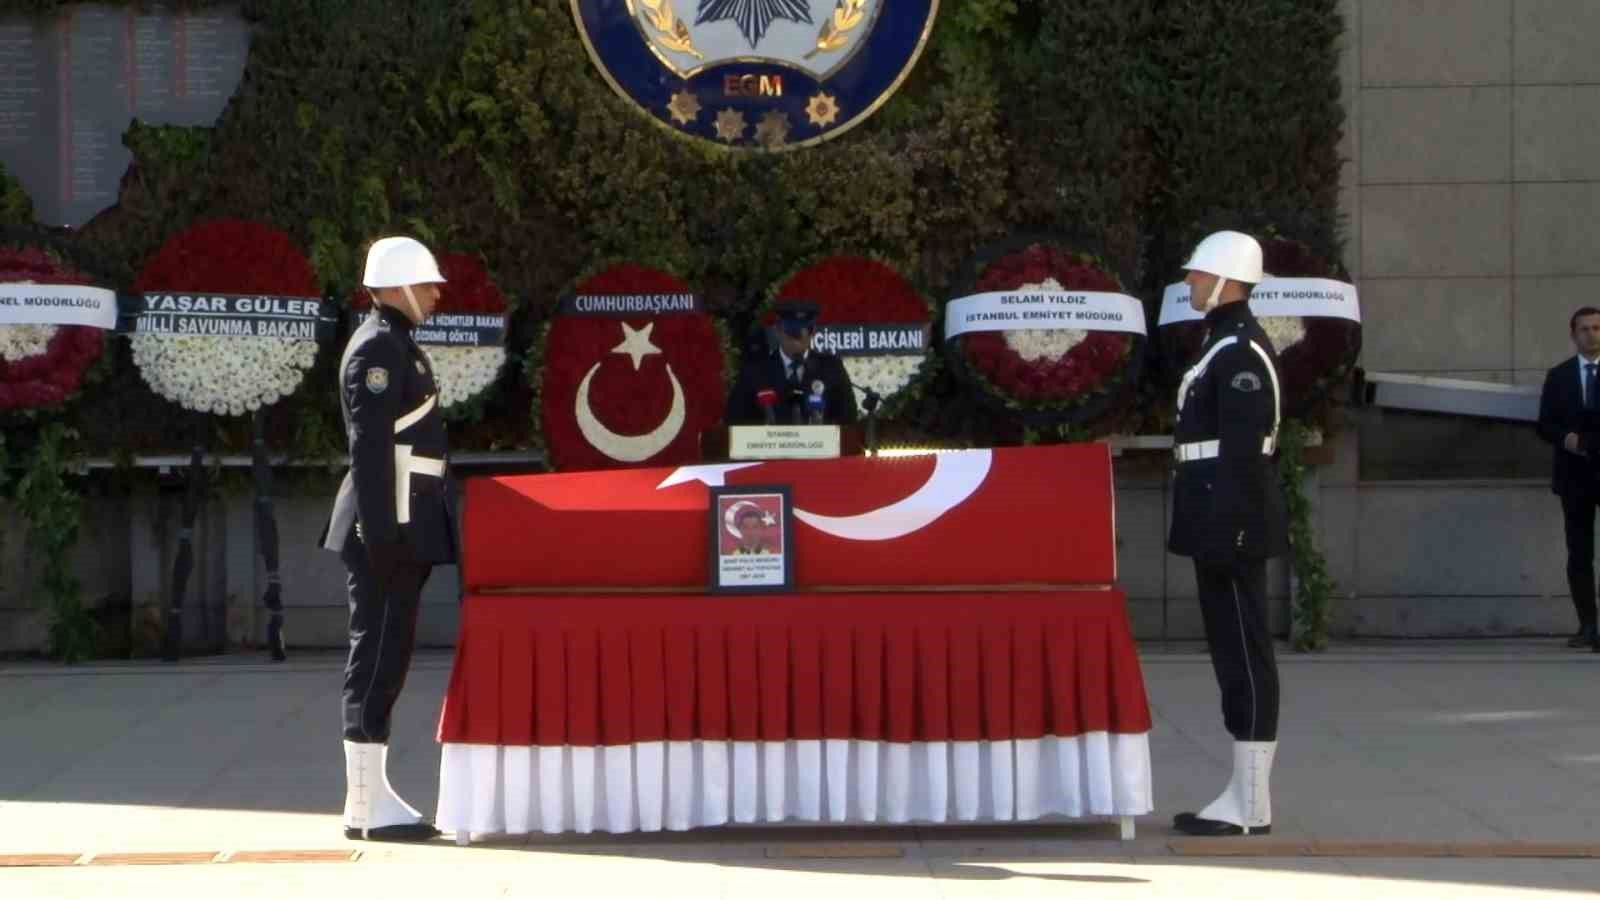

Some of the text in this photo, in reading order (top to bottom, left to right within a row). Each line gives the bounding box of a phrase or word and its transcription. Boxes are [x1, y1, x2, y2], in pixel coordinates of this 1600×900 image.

[723, 75, 782, 97] EGM
[0, 296, 20, 306] NEL
[144, 295, 321, 315] YAŞAR GÜLER
[575, 293, 694, 314] CUMHURBAŞKANI
[1000, 293, 1087, 305] SELAMİ YILDIZ
[137, 313, 316, 338] MİLLİ SAVUNMA BAKANI
[966, 309, 1123, 322] İSTANBUL EMNİYET MÜDÜRÜ
[448, 329, 479, 346] GÖKTAŞ
[868, 329, 923, 349] BAKANI
